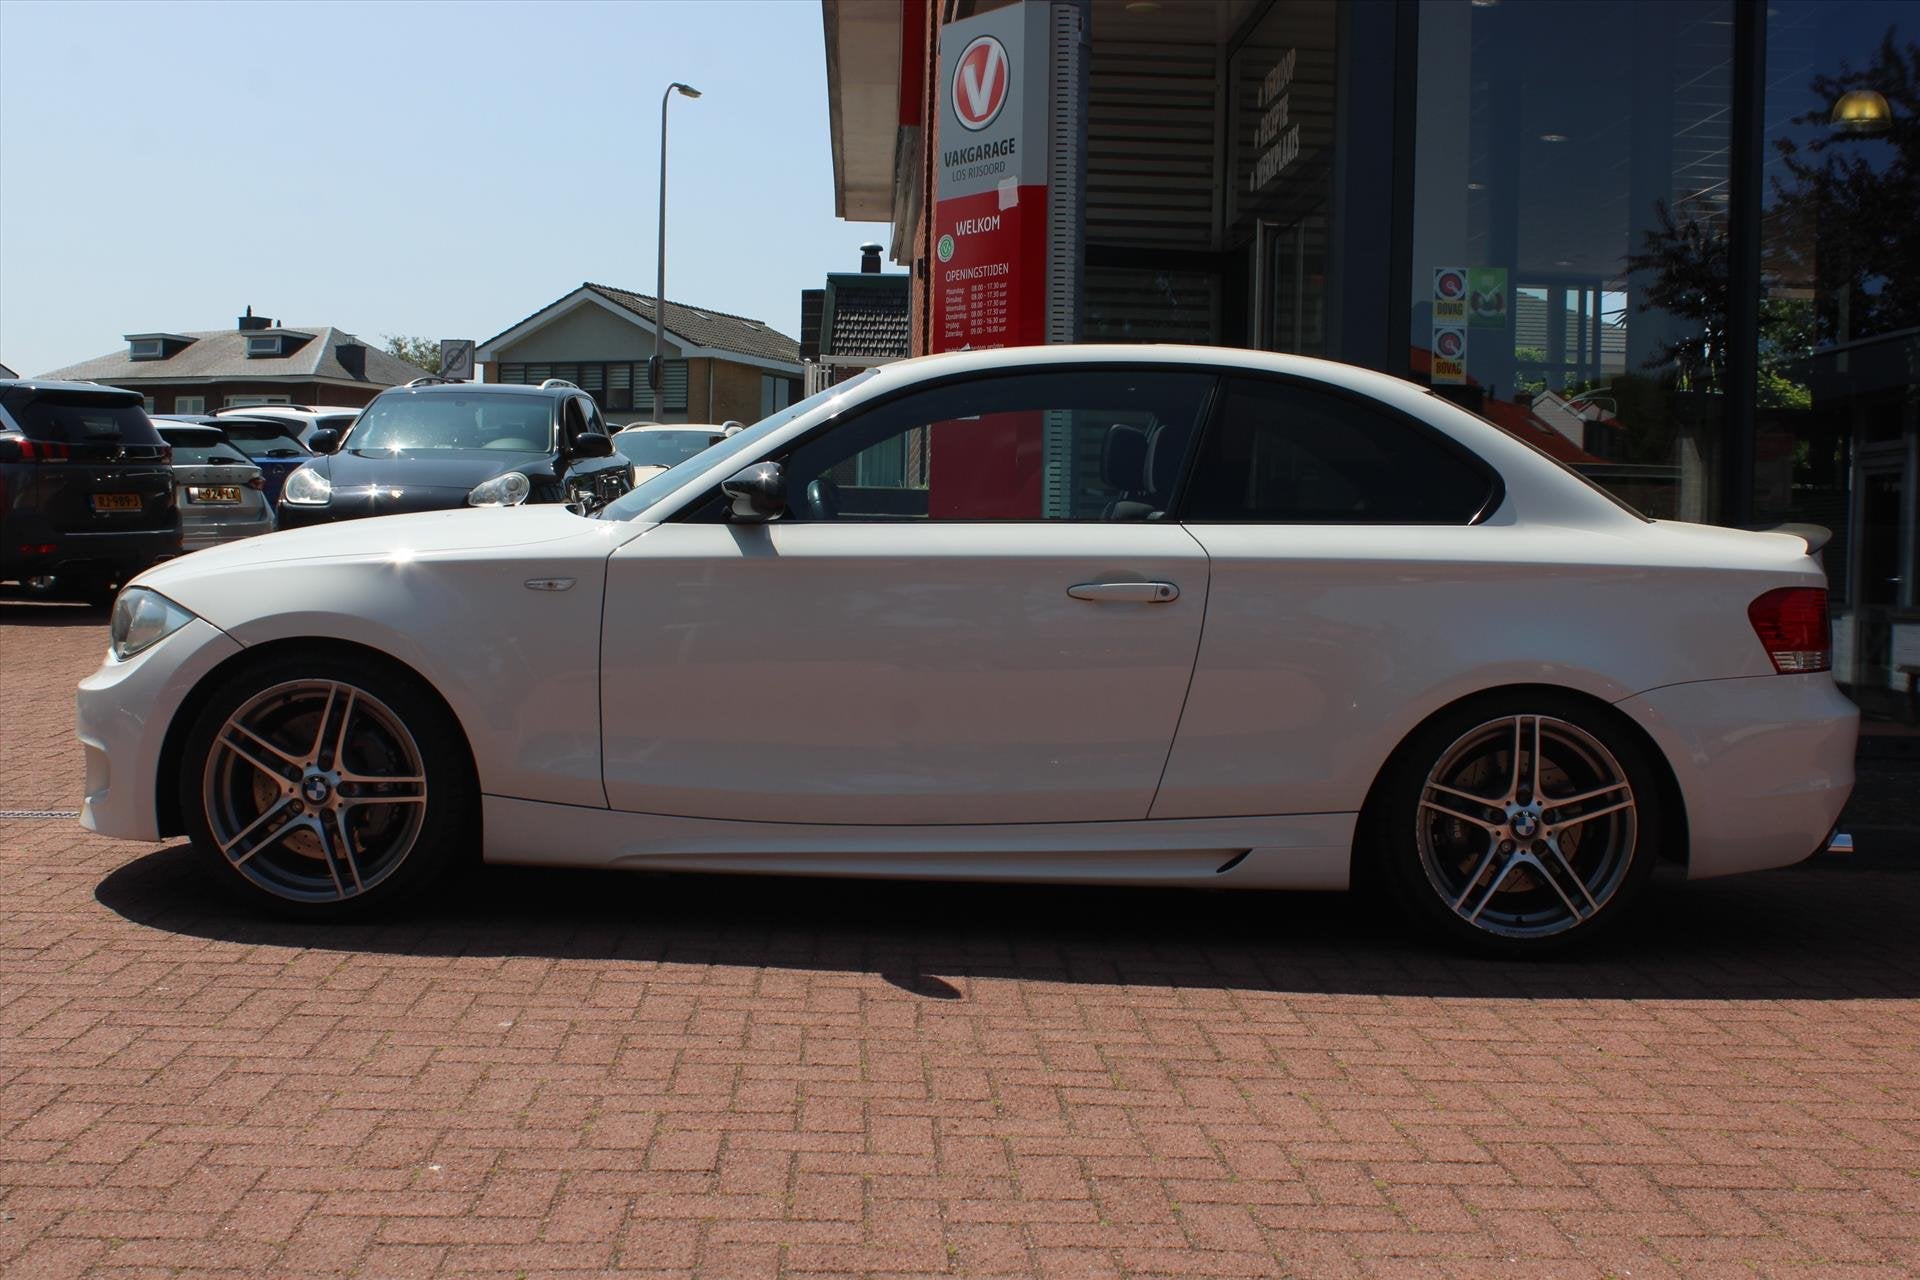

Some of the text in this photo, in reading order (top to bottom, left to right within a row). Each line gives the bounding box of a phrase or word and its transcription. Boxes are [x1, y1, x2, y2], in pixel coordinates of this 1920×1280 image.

[944, 138, 1016, 168] VAKGARAGE
[1257, 123, 1300, 191] WERKPLAATS
[952, 160, 1006, 183] LOS RIJSOORD
[956, 215, 1000, 237] WELKOM
[945, 263, 1009, 282] OPENINGSTIJDEN
[1437, 302, 1463, 316] BOVAG
[1436, 361, 1462, 376] BOVAG
